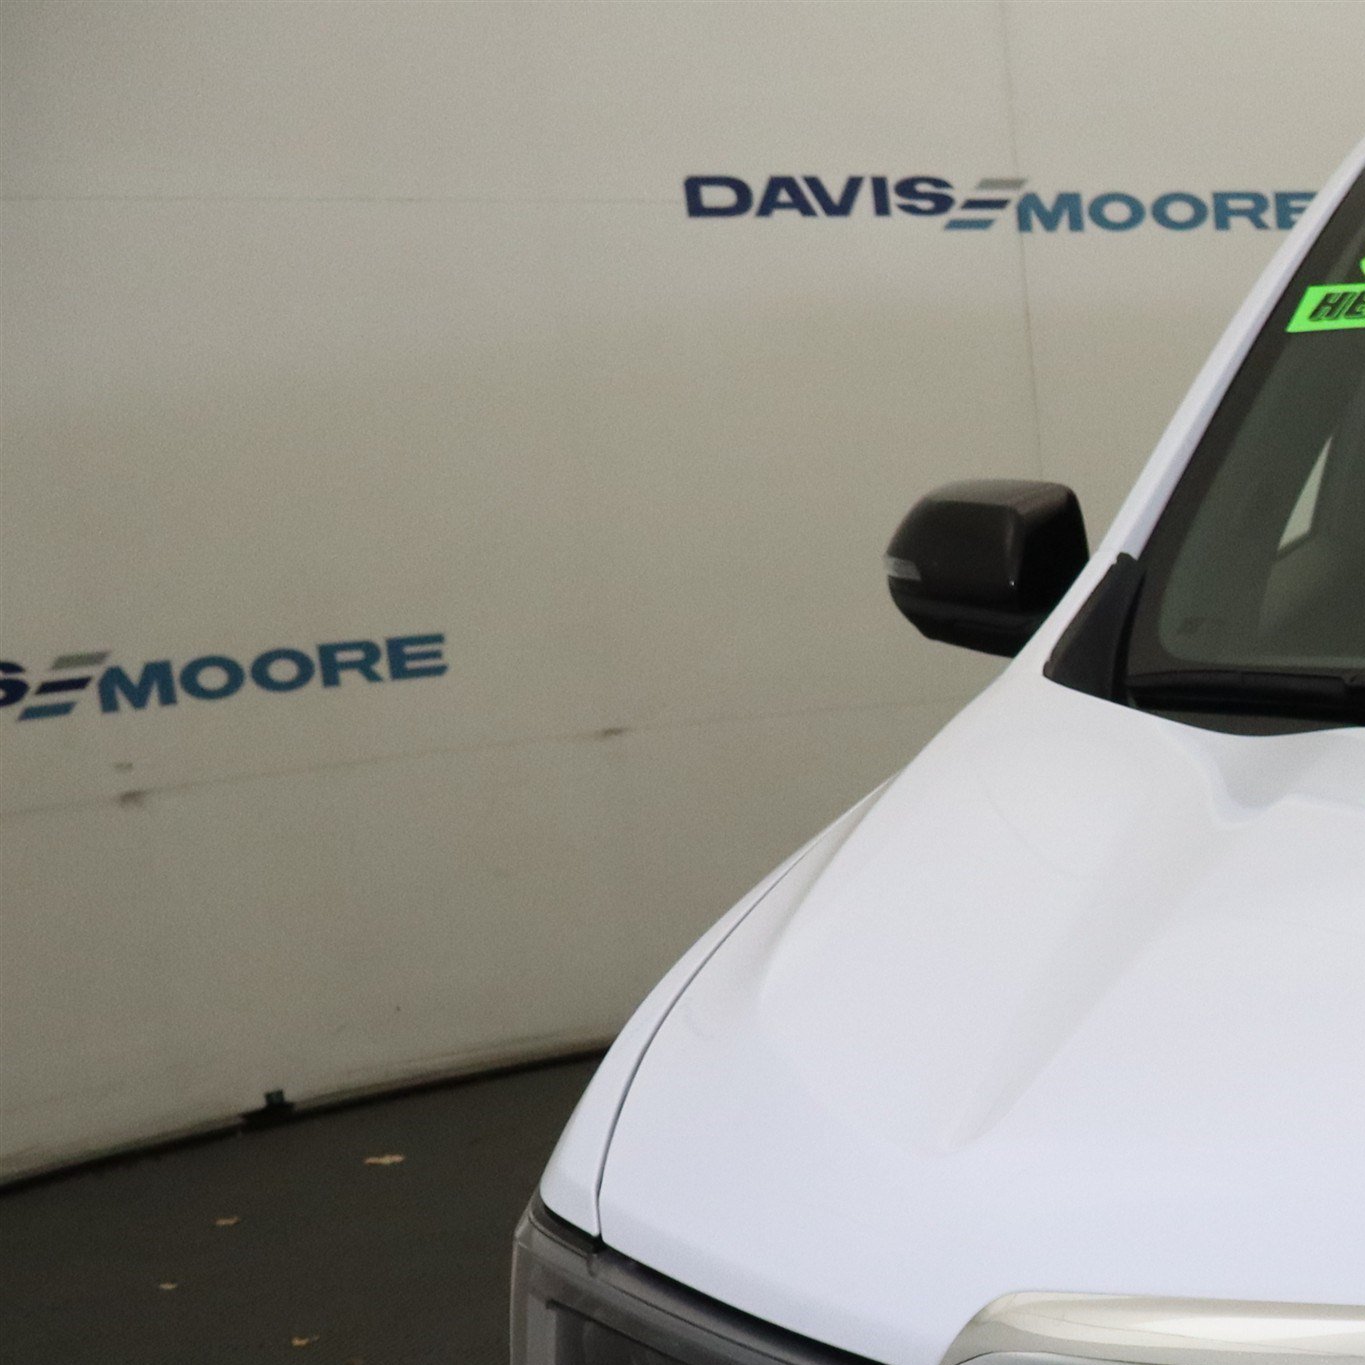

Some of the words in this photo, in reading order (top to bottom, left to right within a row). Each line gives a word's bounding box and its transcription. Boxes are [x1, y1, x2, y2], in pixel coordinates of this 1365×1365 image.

[684, 175, 955, 219] DAVIS
[1014, 191, 1318, 233] MOORE
[97, 633, 448, 713] MOORE
